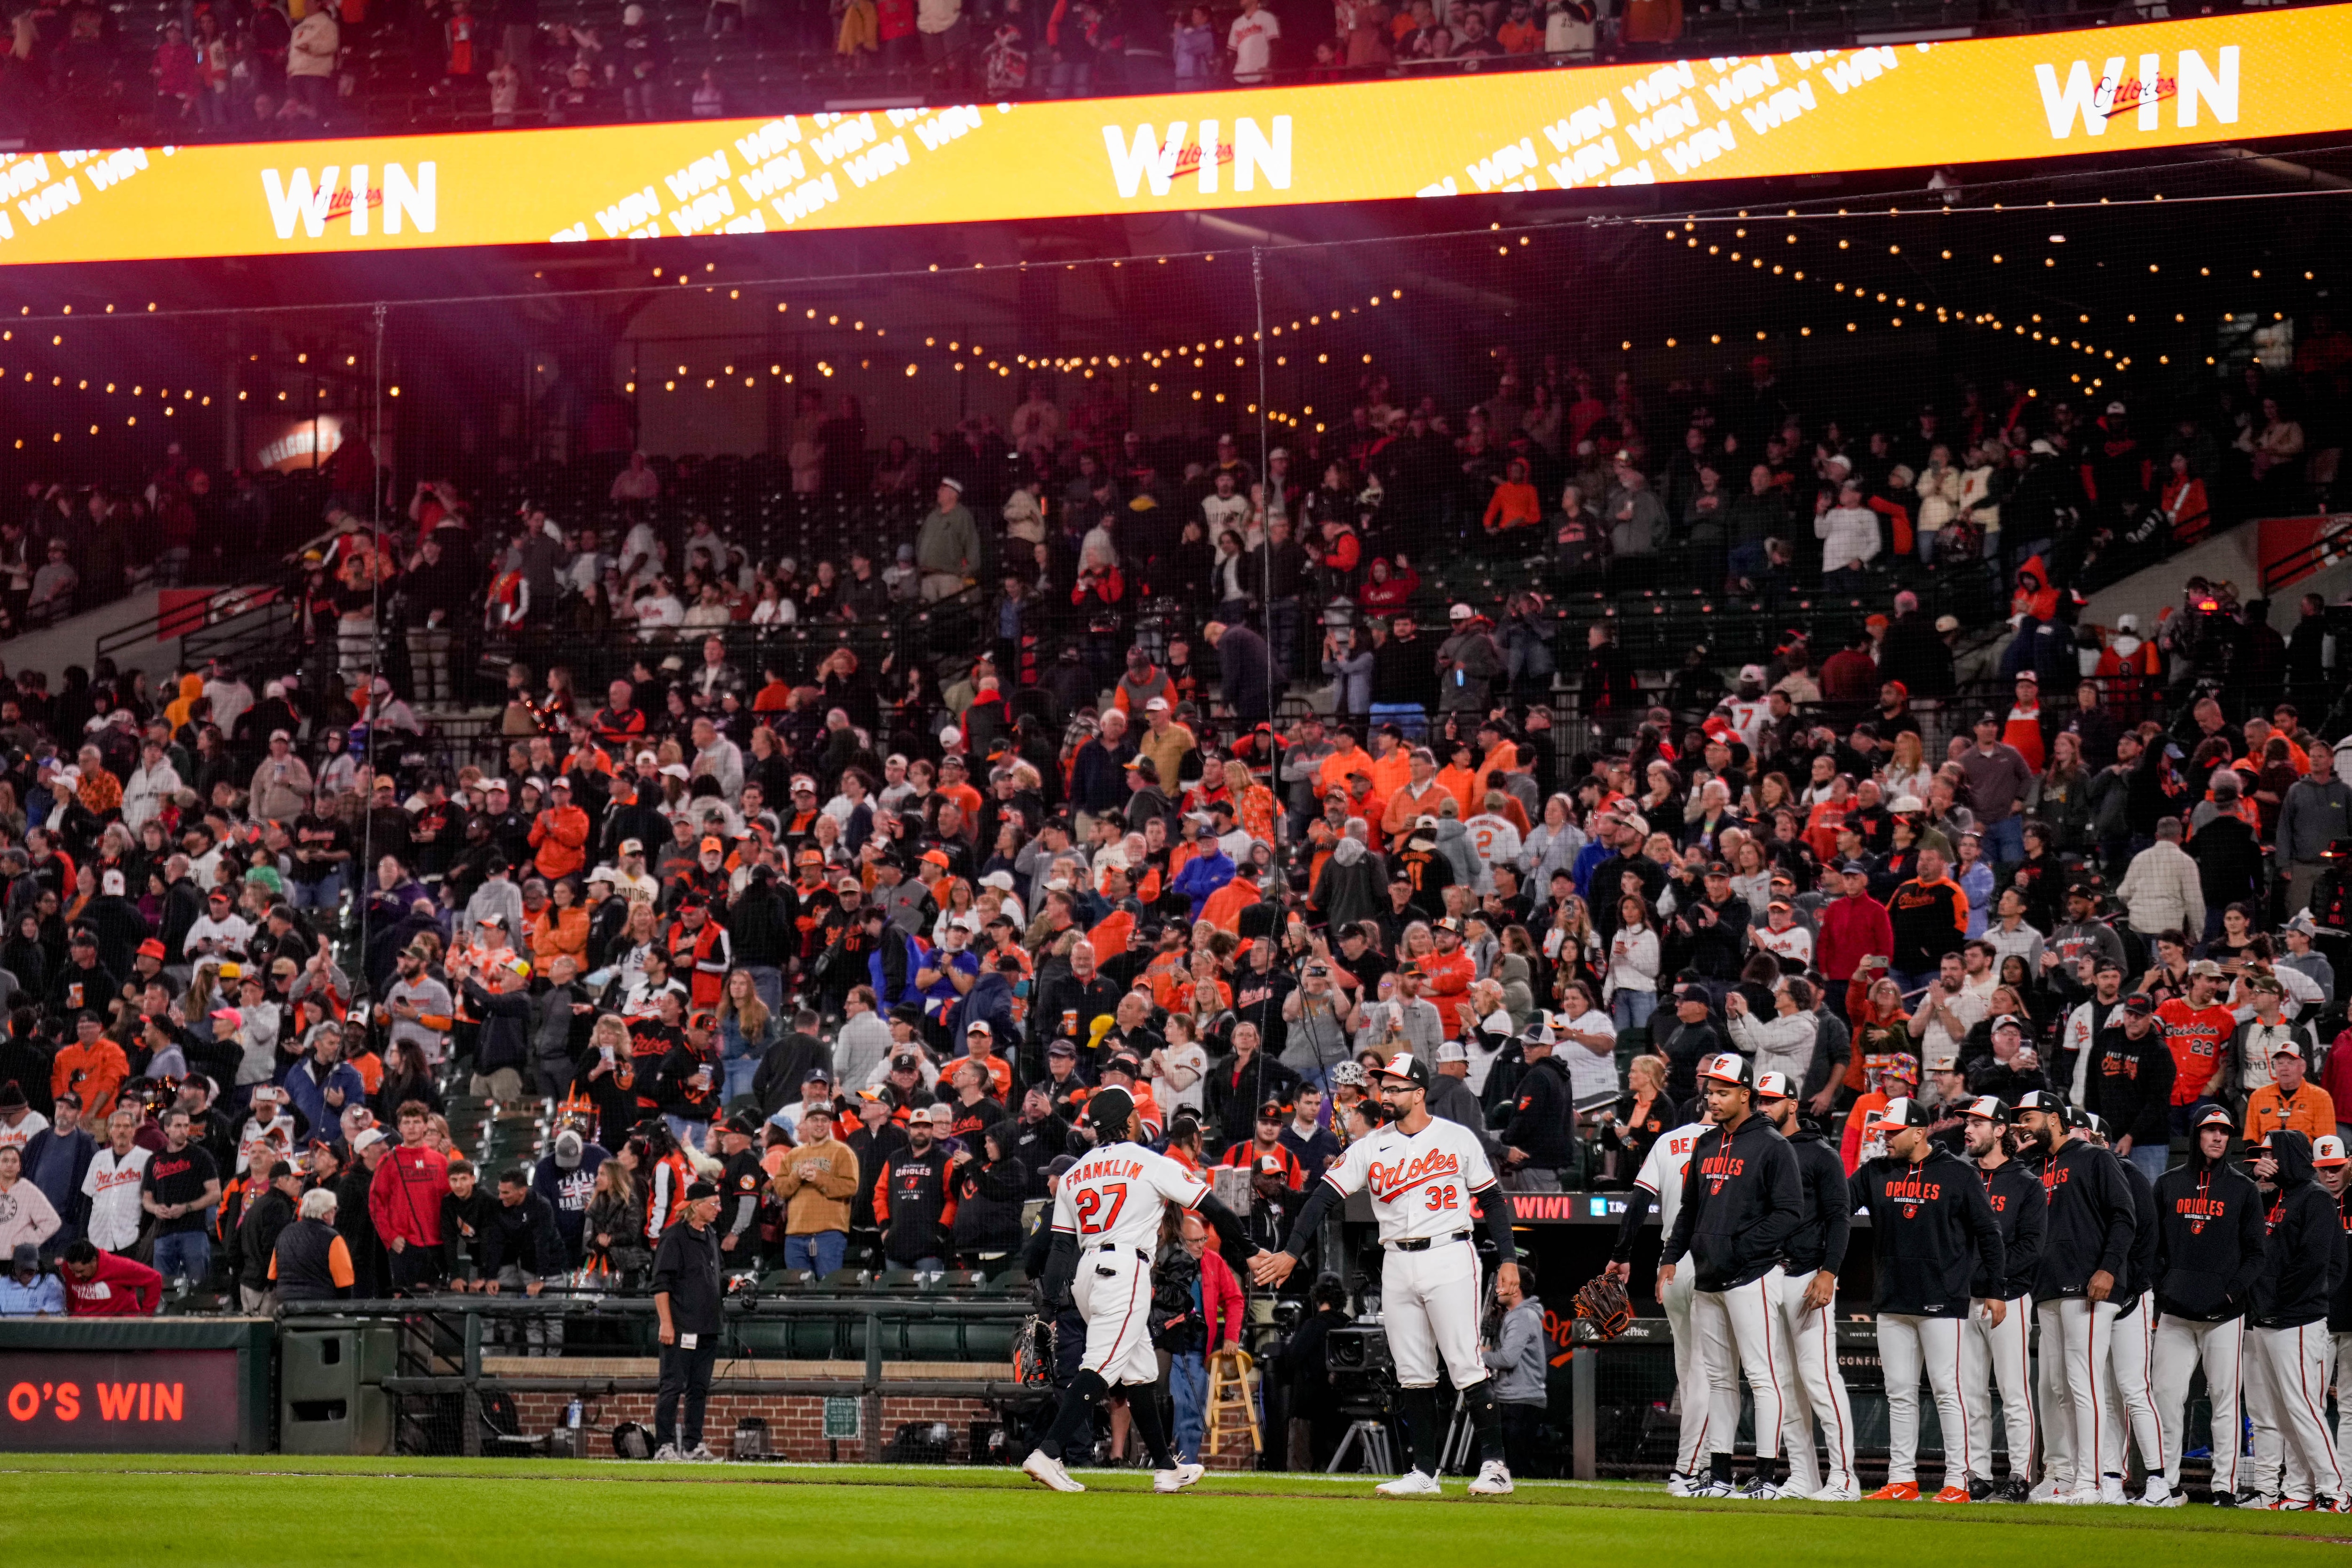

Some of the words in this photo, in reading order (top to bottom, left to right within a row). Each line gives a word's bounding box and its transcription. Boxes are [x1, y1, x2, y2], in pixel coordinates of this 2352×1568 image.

[1661, 119, 1737, 175] WIN
[1741, 80, 1817, 135] WIN
[1822, 47, 1898, 94] WIN
[2034, 45, 2240, 139] WIN
[2094, 73, 2176, 118] Orioles
[1466, 137, 1538, 191] WIN
[1543, 97, 1617, 152] WIN
[1621, 61, 1696, 113] WIN
[1547, 135, 1621, 189] WIN
[1625, 96, 1700, 151] WIN
[1704, 56, 1780, 111] WIN
[595, 186, 661, 238] WIN
[665, 150, 731, 202] WIN
[735, 116, 803, 165] WIN
[668, 185, 735, 236] WIN
[739, 149, 806, 201] WIN
[809, 112, 877, 165] WIN
[771, 172, 839, 224] WIN
[842, 135, 910, 188] WIN
[914, 105, 982, 151] WIN
[1102, 115, 1292, 198] WIN
[18, 176, 81, 225] WIN
[85, 147, 149, 191] WIN
[261, 161, 436, 239] WIN
[1740, 709, 1753, 730] 7
[1477, 831, 1492, 857] 2
[2165, 1022, 2218, 1038] Orioles
[2190, 1039, 2214, 1058] 22
[557, 1169, 595, 1190] TEXAS
[895, 1168, 931, 1177] ORIOLES
[1066, 1160, 1143, 1190] FRANKLIN
[1368, 1148, 1458, 1196] Orioles
[1700, 1157, 1744, 1176] ORIOLES
[1075, 1183, 1127, 1234] 27
[1425, 1185, 1458, 1211] 32
[1885, 1180, 1940, 1201] ORIOLES
[2176, 1199, 2224, 1217] ORIOLES
[8, 1382, 80, 1421] O'S
[97, 1382, 184, 1421] WIN
